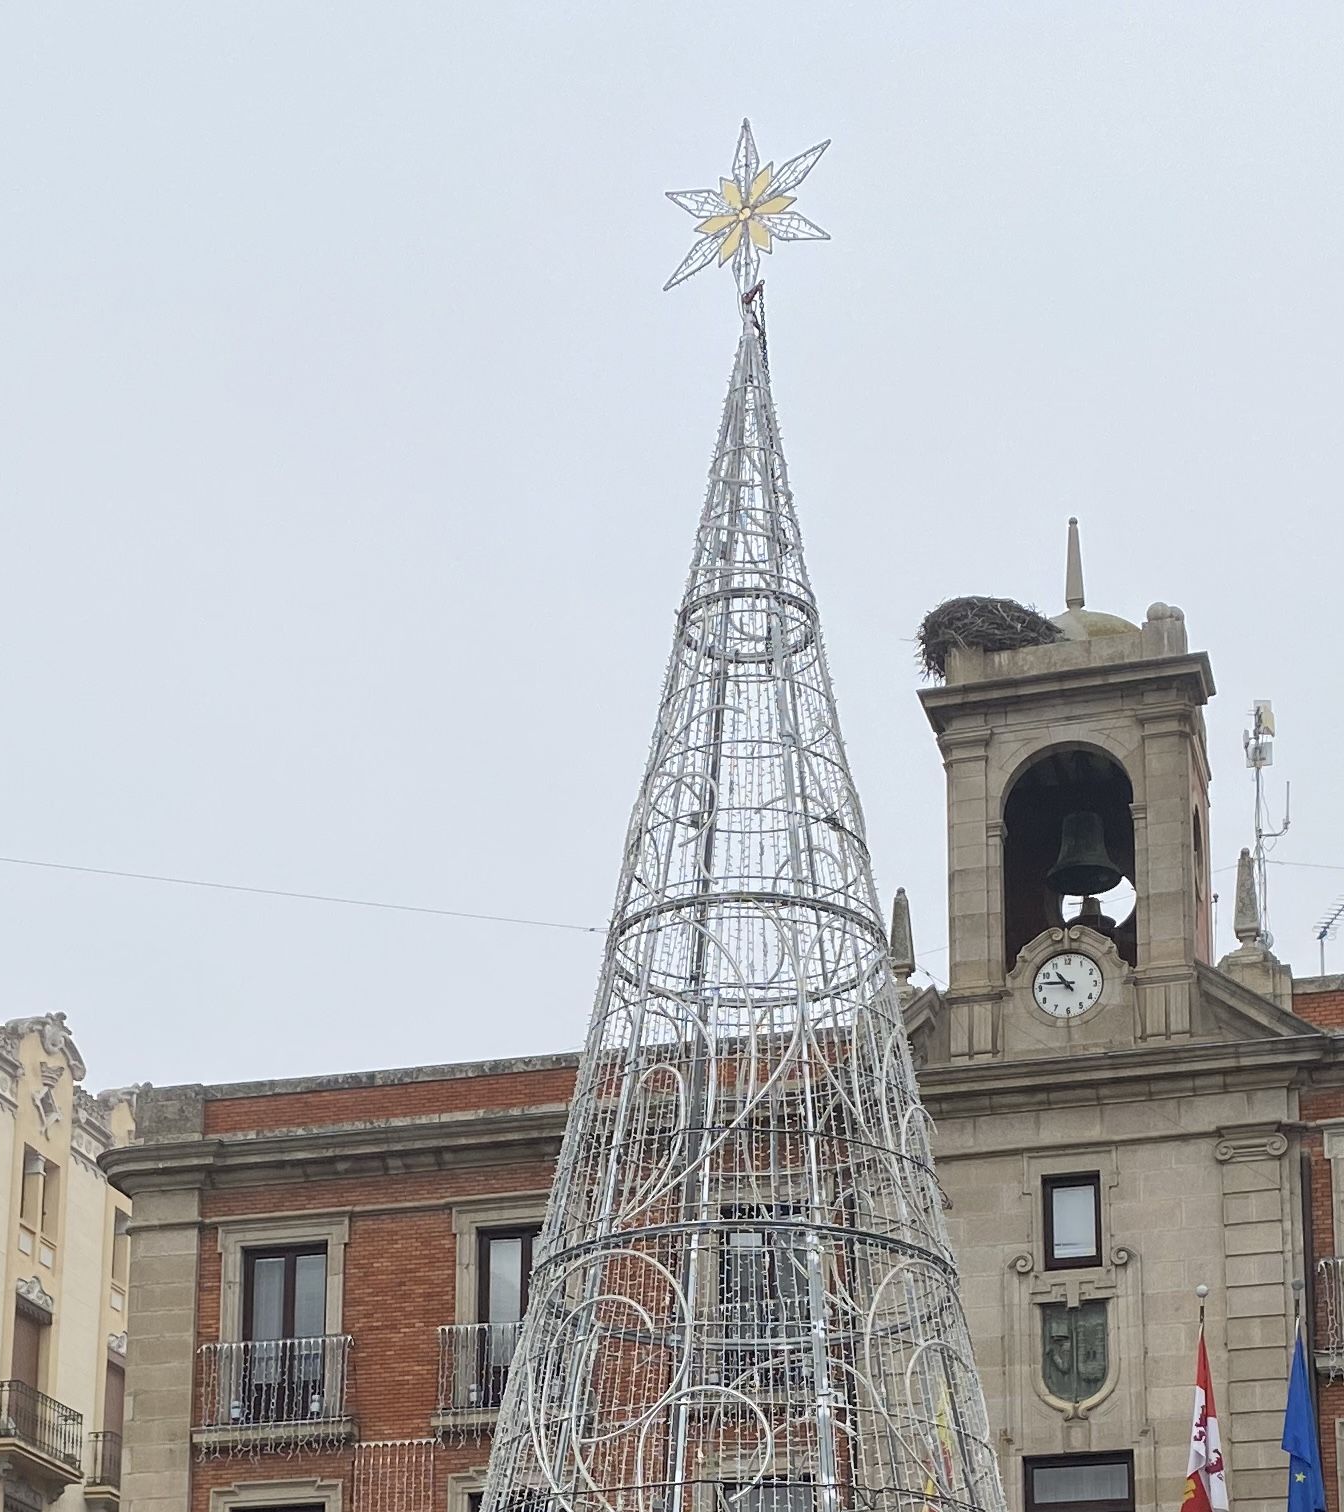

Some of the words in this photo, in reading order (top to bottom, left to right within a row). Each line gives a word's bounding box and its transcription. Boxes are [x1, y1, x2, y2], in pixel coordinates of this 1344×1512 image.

[1080, 960, 1083, 968] 1
[1042, 972, 1050, 980] 10
[1089, 968, 1094, 976] 2
[1053, 1004, 1058, 1012] 7
[1066, 1007, 1071, 1015] 6
